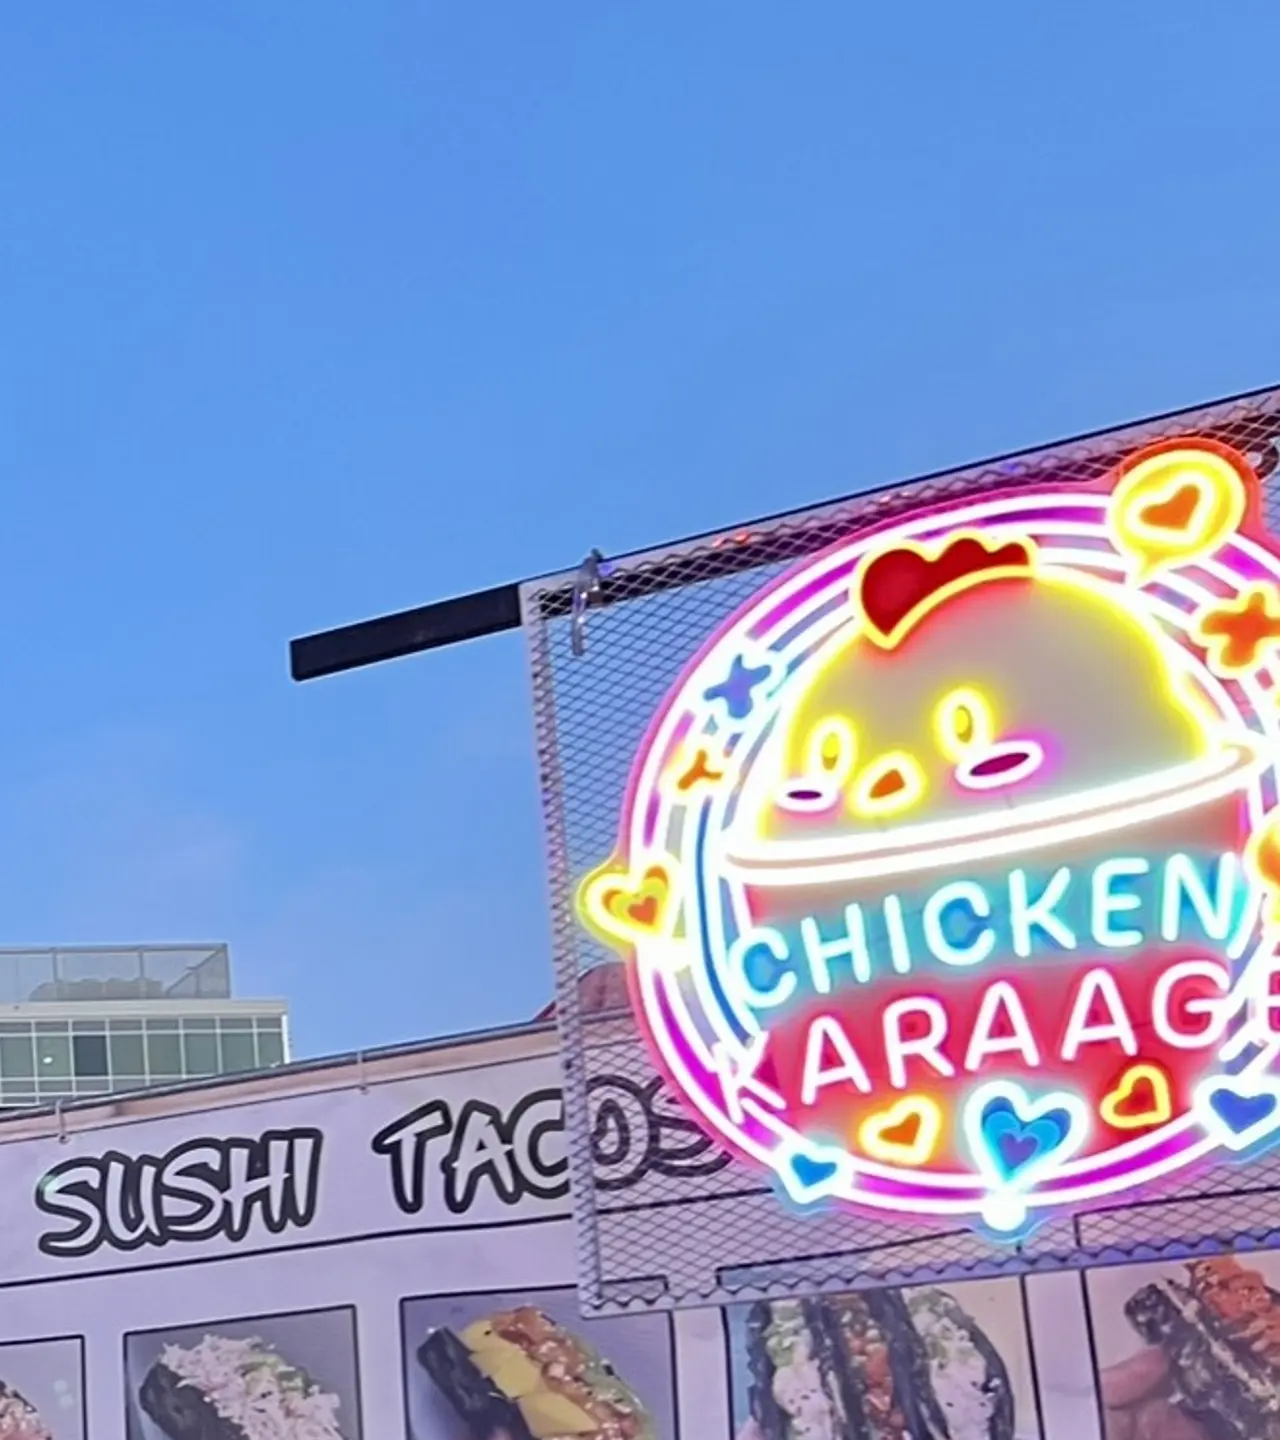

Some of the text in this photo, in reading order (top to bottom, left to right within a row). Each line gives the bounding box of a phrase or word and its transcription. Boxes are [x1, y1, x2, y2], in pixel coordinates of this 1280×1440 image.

[728, 850, 1243, 1008] CHICKEN
[37, 1075, 734, 1256] SUSHI TACOS
